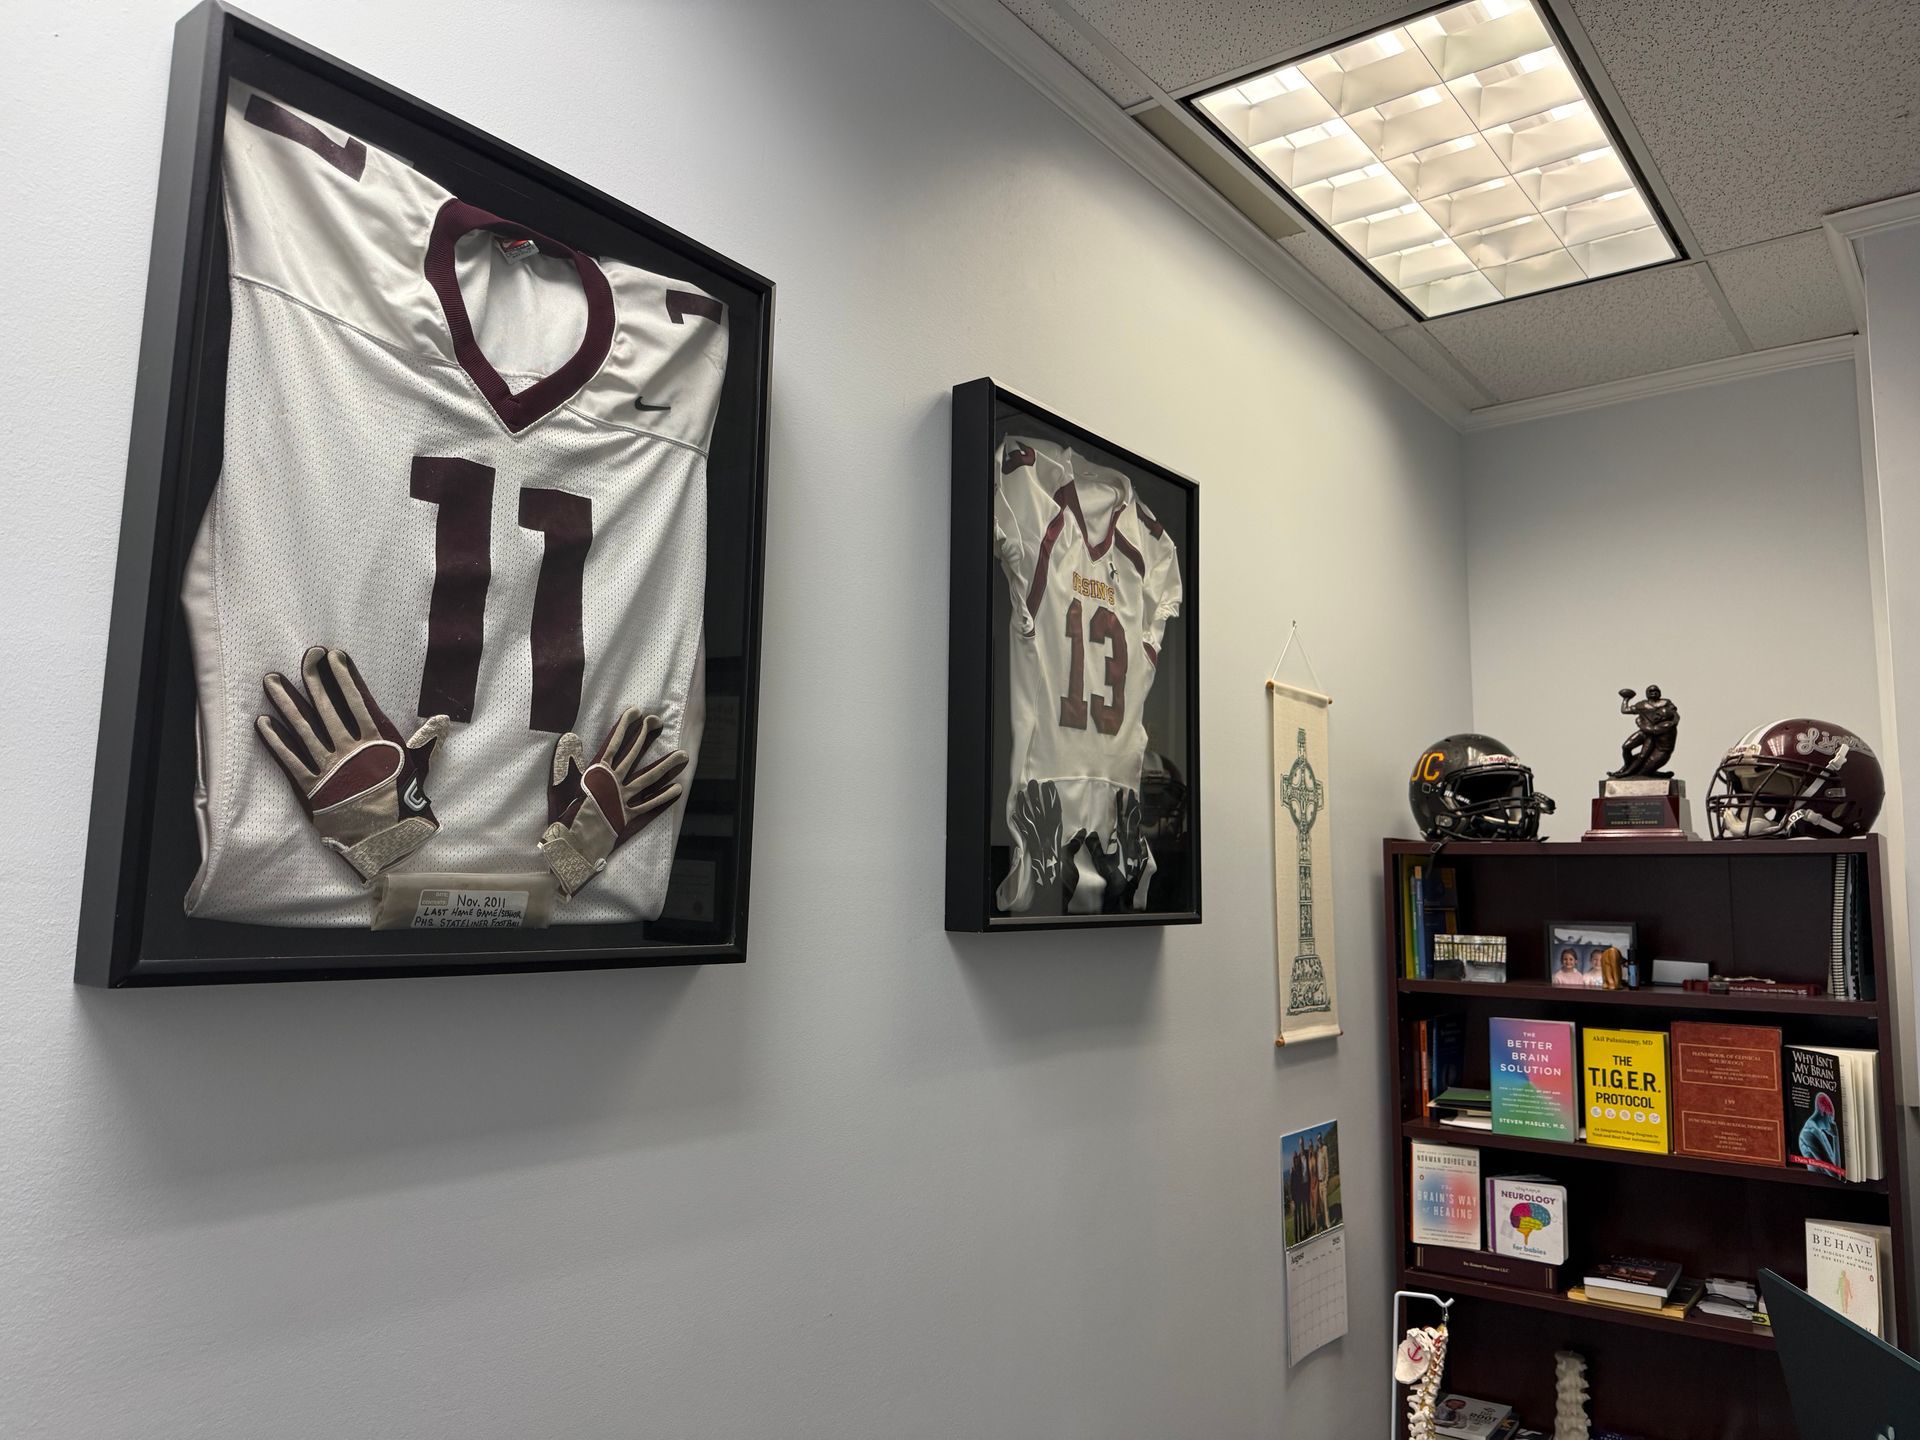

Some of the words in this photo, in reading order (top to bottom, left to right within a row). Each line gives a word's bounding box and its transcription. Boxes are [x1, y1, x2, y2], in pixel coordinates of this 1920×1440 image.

[410, 456, 593, 734] 11
[1059, 597, 1128, 736] 13
[457, 894, 480, 908] Nov.
[484, 896, 506, 908] 2011
[424, 906, 449, 917] LAST
[1507, 1040, 1552, 1050] BETTER
[1512, 1052, 1549, 1062] BRAIN
[1612, 1055, 1632, 1066] THE
[1792, 1050, 1814, 1065] WHY
[1500, 1064, 1561, 1076] SOLUTION
[1794, 1062, 1809, 1074] MY
[1810, 1064, 1834, 1080] BRAIN
[1588, 1066, 1662, 1093] T.I.G.E.R.
[1792, 1072, 1837, 1092] WORKING?
[1596, 1092, 1654, 1109] PROTOCOL
[1458, 1195, 1477, 1208] WAY
[1501, 1190, 1556, 1205] NEUROLOGY
[1433, 1206, 1472, 1220] HEALING
[1812, 1234, 1873, 1259] BEHAVE
